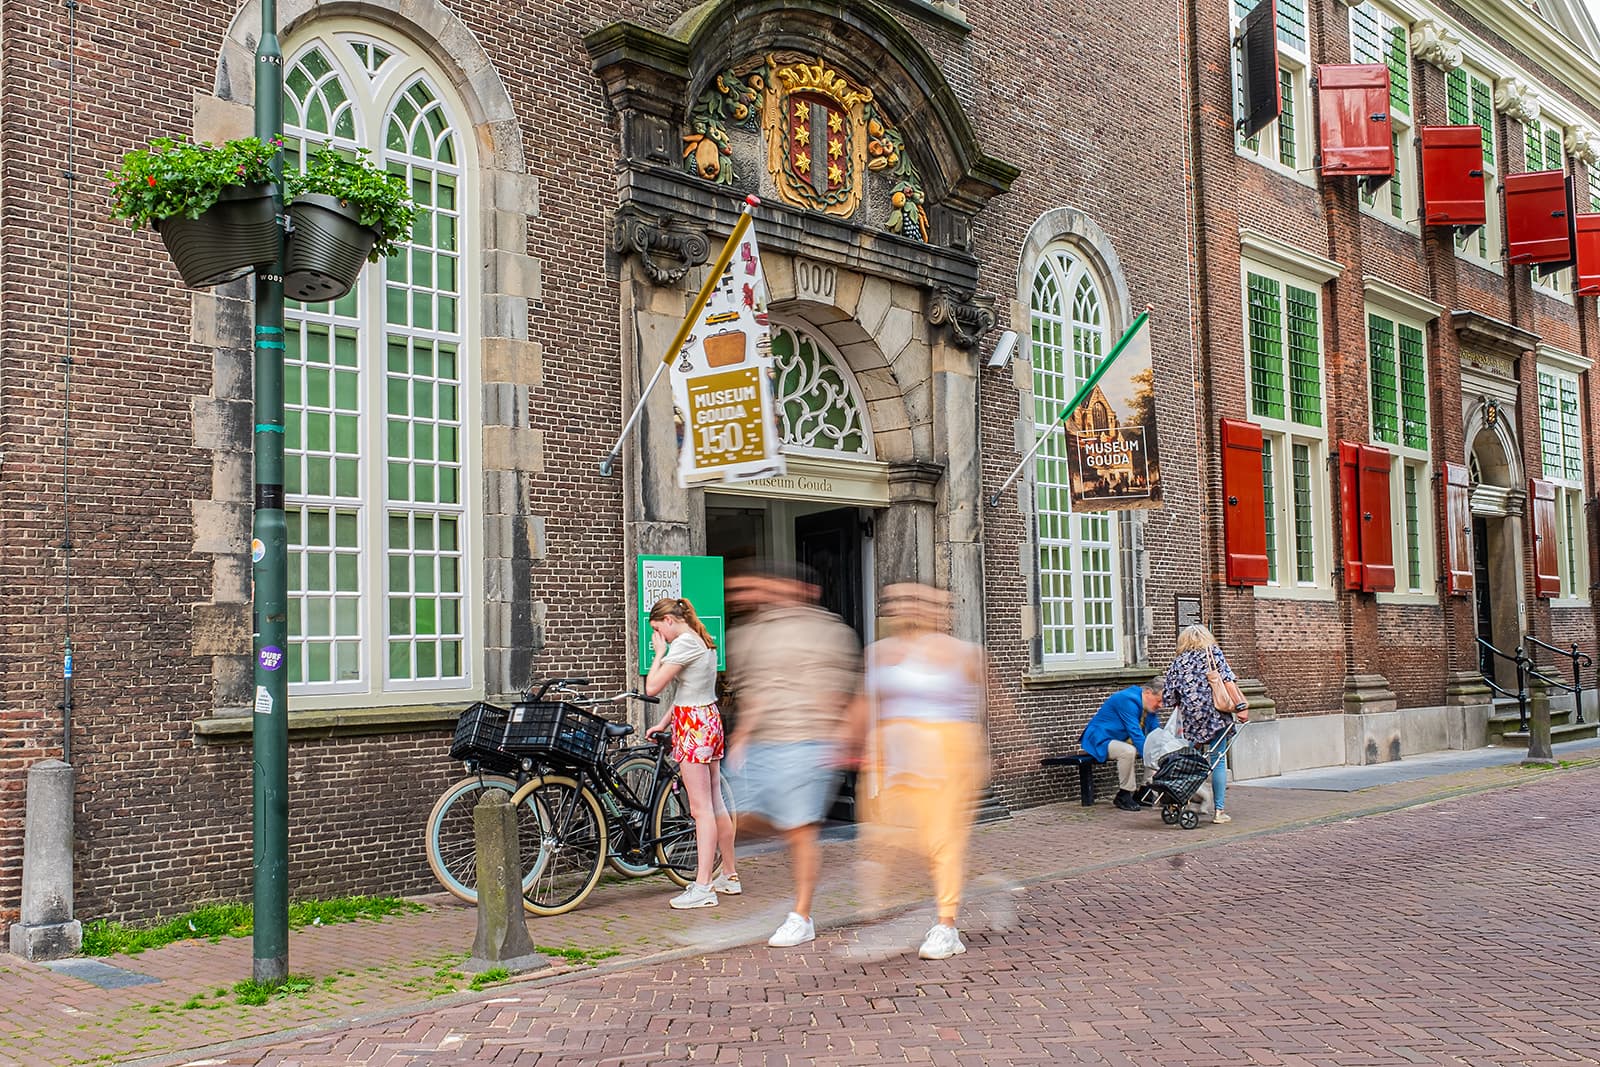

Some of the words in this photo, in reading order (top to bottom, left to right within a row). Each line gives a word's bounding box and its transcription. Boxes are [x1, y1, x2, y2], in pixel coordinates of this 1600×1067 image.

[694, 386, 756, 408] MUSEUM
[696, 405, 747, 424] GOUDA
[698, 422, 744, 454] 150
[1085, 440, 1139, 454] MUSEUM
[1086, 453, 1130, 467] GOUDA
[797, 476, 832, 491] Gouda
[647, 570, 678, 579] MUSEUM
[647, 579, 673, 588] GOUDA
[261, 651, 281, 660] DURF
[262, 659, 278, 667] JE?
